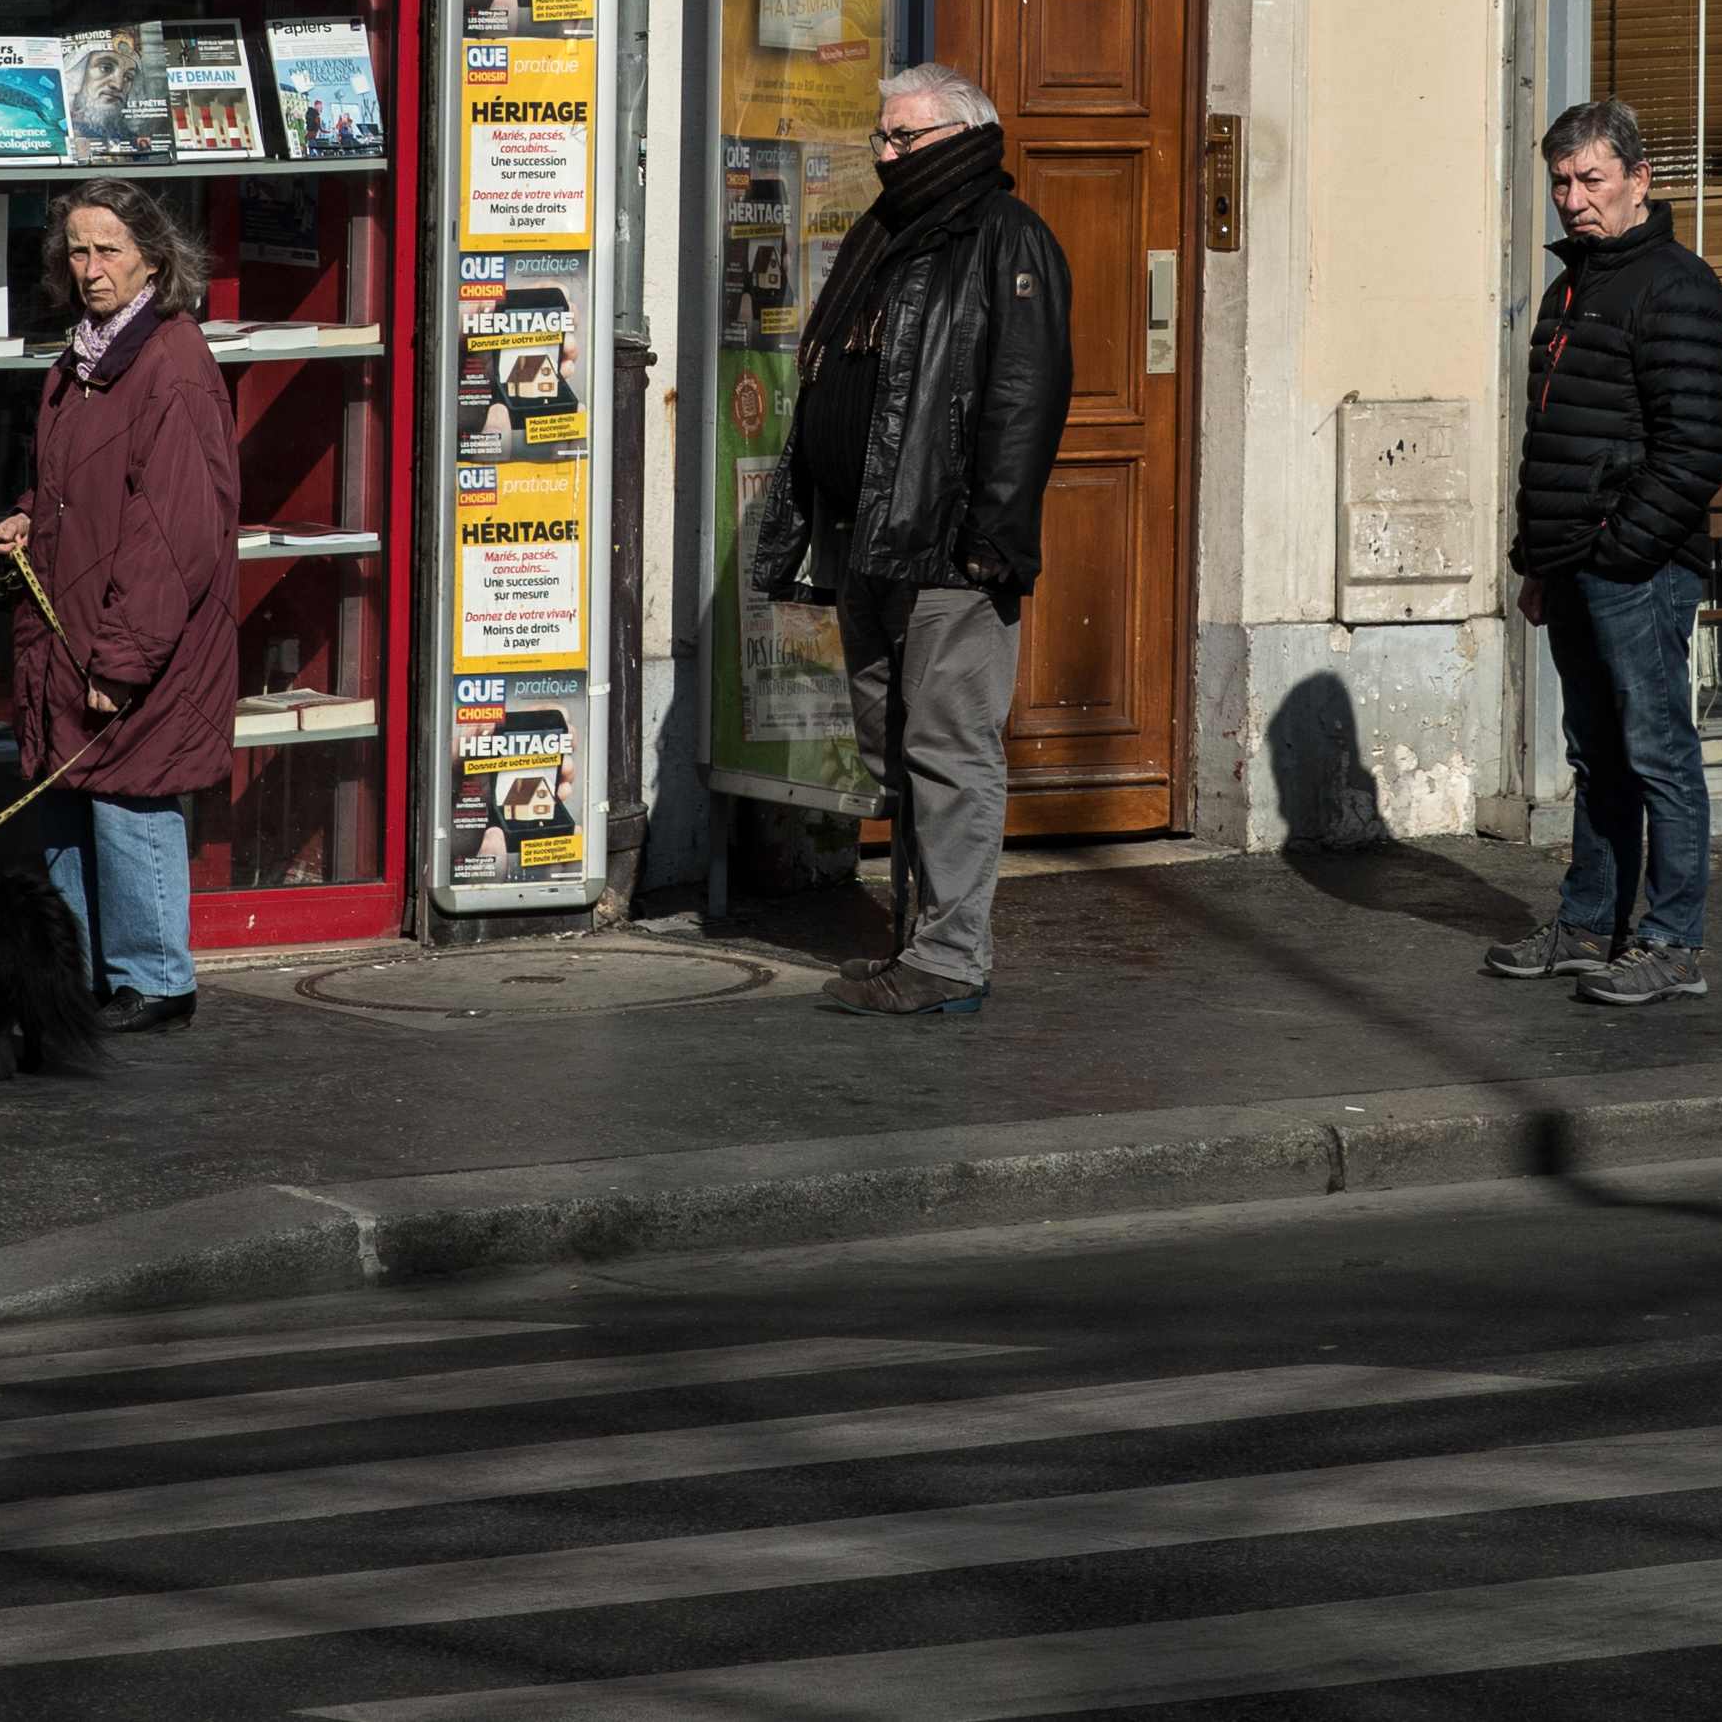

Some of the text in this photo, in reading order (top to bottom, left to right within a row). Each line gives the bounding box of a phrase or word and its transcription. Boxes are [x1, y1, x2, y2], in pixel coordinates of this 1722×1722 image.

[272, 19, 333, 39] Papiers
[468, 47, 579, 75] QUE pratique
[185, 69, 237, 83] DEMAIN
[468, 71, 507, 82] CHOISIR
[127, 98, 168, 109] LE PRÊTRE
[471, 96, 588, 122] HÉRITAGE
[492, 130, 566, 144] Mariés, pacsés,
[491, 156, 567, 166] Une succession
[726, 146, 750, 168] QUE
[501, 170, 556, 179] sur mesure
[472, 189, 584, 201] Donnez de votre vivant
[490, 203, 567, 214] Moins de droits
[509, 215, 546, 229] à payer
[461, 255, 579, 279] QUE pratique
[460, 284, 504, 297] CHOISIR
[462, 309, 575, 334] HÉRITAGE
[458, 468, 569, 495] QUE pratique
[459, 492, 496, 504] CHOISIR
[461, 516, 579, 544] HÉRITAGE
[484, 551, 558, 565] Mariés, pacsés,
[484, 576, 559, 588] Une succession
[494, 590, 549, 601] sur mesure
[465, 609, 577, 622] Donnez de votre vivant
[483, 623, 560, 636] Moins de droits
[503, 636, 540, 649] à payer
[457, 678, 578, 702] QUE pratique
[458, 708, 503, 720] CHOISIR
[459, 730, 574, 757] HÉRITAGE
